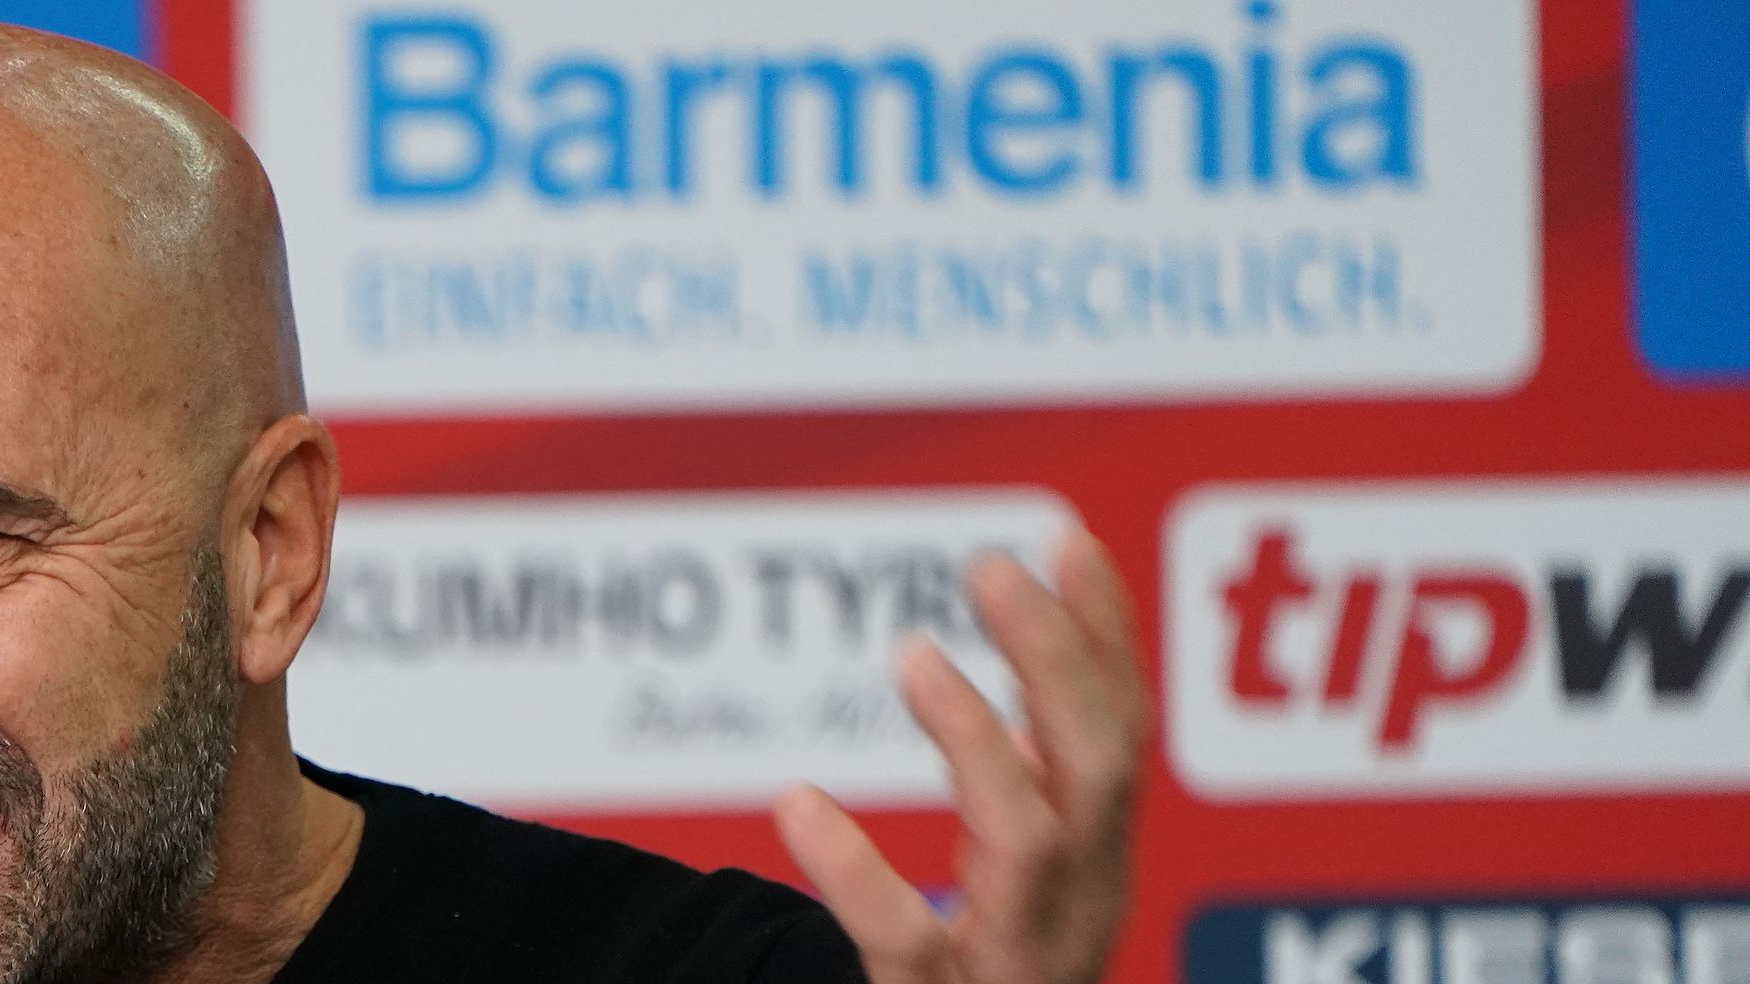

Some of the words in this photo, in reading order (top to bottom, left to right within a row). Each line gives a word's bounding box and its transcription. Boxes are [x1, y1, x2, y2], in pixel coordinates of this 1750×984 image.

[358, 0, 1418, 198] Barmenia
[355, 250, 768, 345] EINFACH.
[800, 236, 1434, 340] MENSCHLICH.
[748, 540, 1022, 648] TYR
[1220, 530, 1750, 755] tipw
